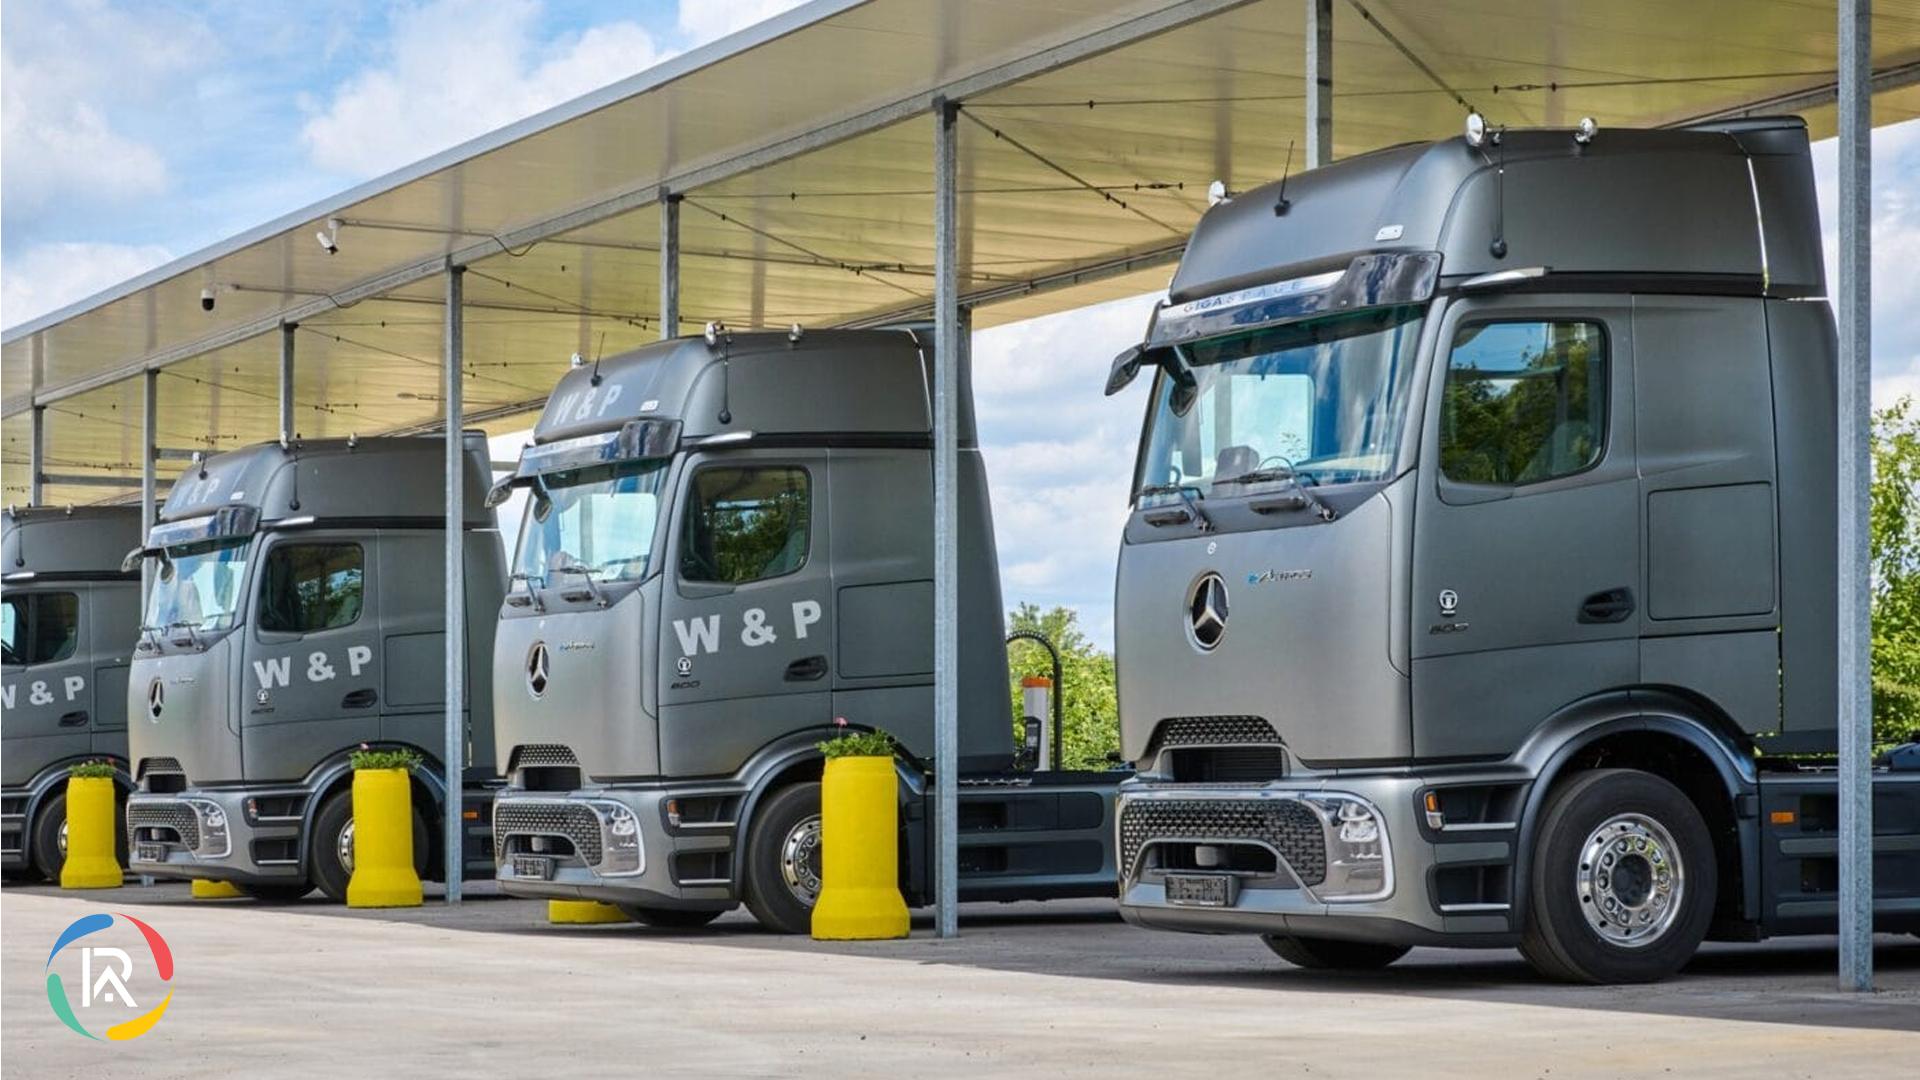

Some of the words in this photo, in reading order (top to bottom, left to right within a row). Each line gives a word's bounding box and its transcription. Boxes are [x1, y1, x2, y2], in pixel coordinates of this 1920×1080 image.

[552, 392, 580, 426] W
[575, 388, 597, 421] &
[597, 384, 623, 417] P
[673, 614, 720, 656] W
[741, 608, 777, 646] &
[792, 600, 821, 639] P
[253, 656, 291, 689] W
[307, 651, 336, 681] &
[347, 645, 372, 676] P
[29, 680, 55, 705] &
[64, 676, 85, 700] P
